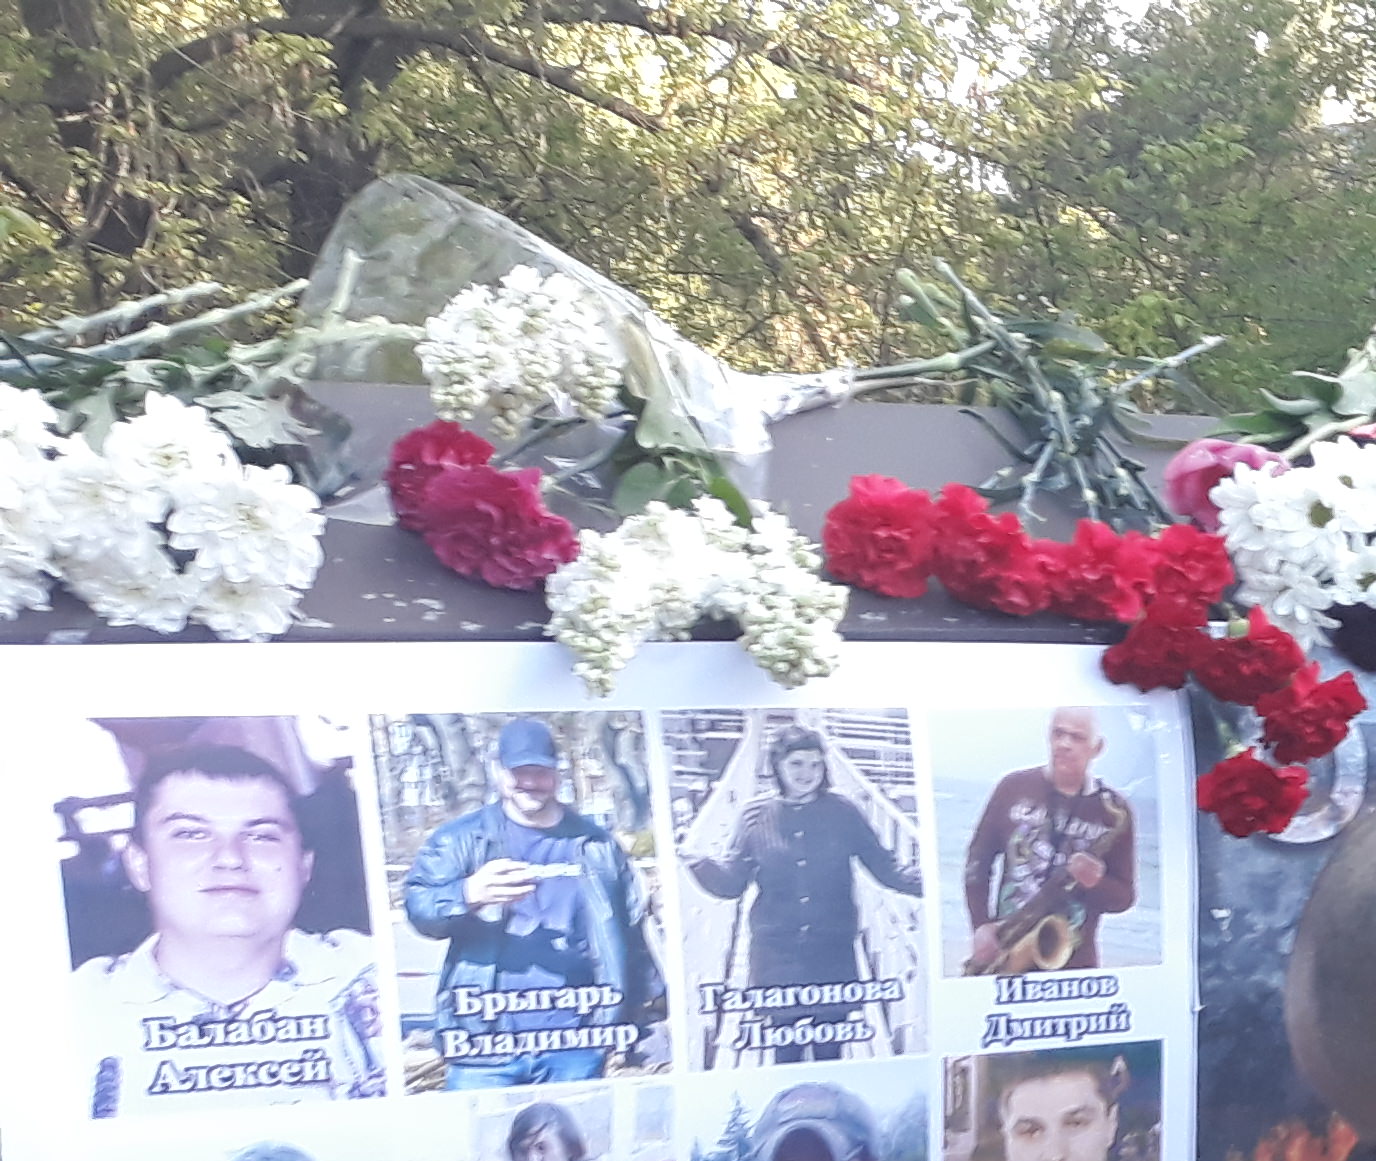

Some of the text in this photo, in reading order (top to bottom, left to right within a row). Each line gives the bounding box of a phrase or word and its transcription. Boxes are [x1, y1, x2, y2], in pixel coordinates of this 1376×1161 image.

[454, 983, 625, 1018] Брыгарь
[700, 973, 903, 1014] Галагонова
[994, 973, 1119, 1004] Иванов
[143, 1011, 330, 1053] Балабан
[440, 1020, 640, 1062] Владимир
[733, 1017, 874, 1051] Любовь
[982, 1003, 1132, 1049] Дмитрий
[148, 1050, 332, 1095] Алексей
